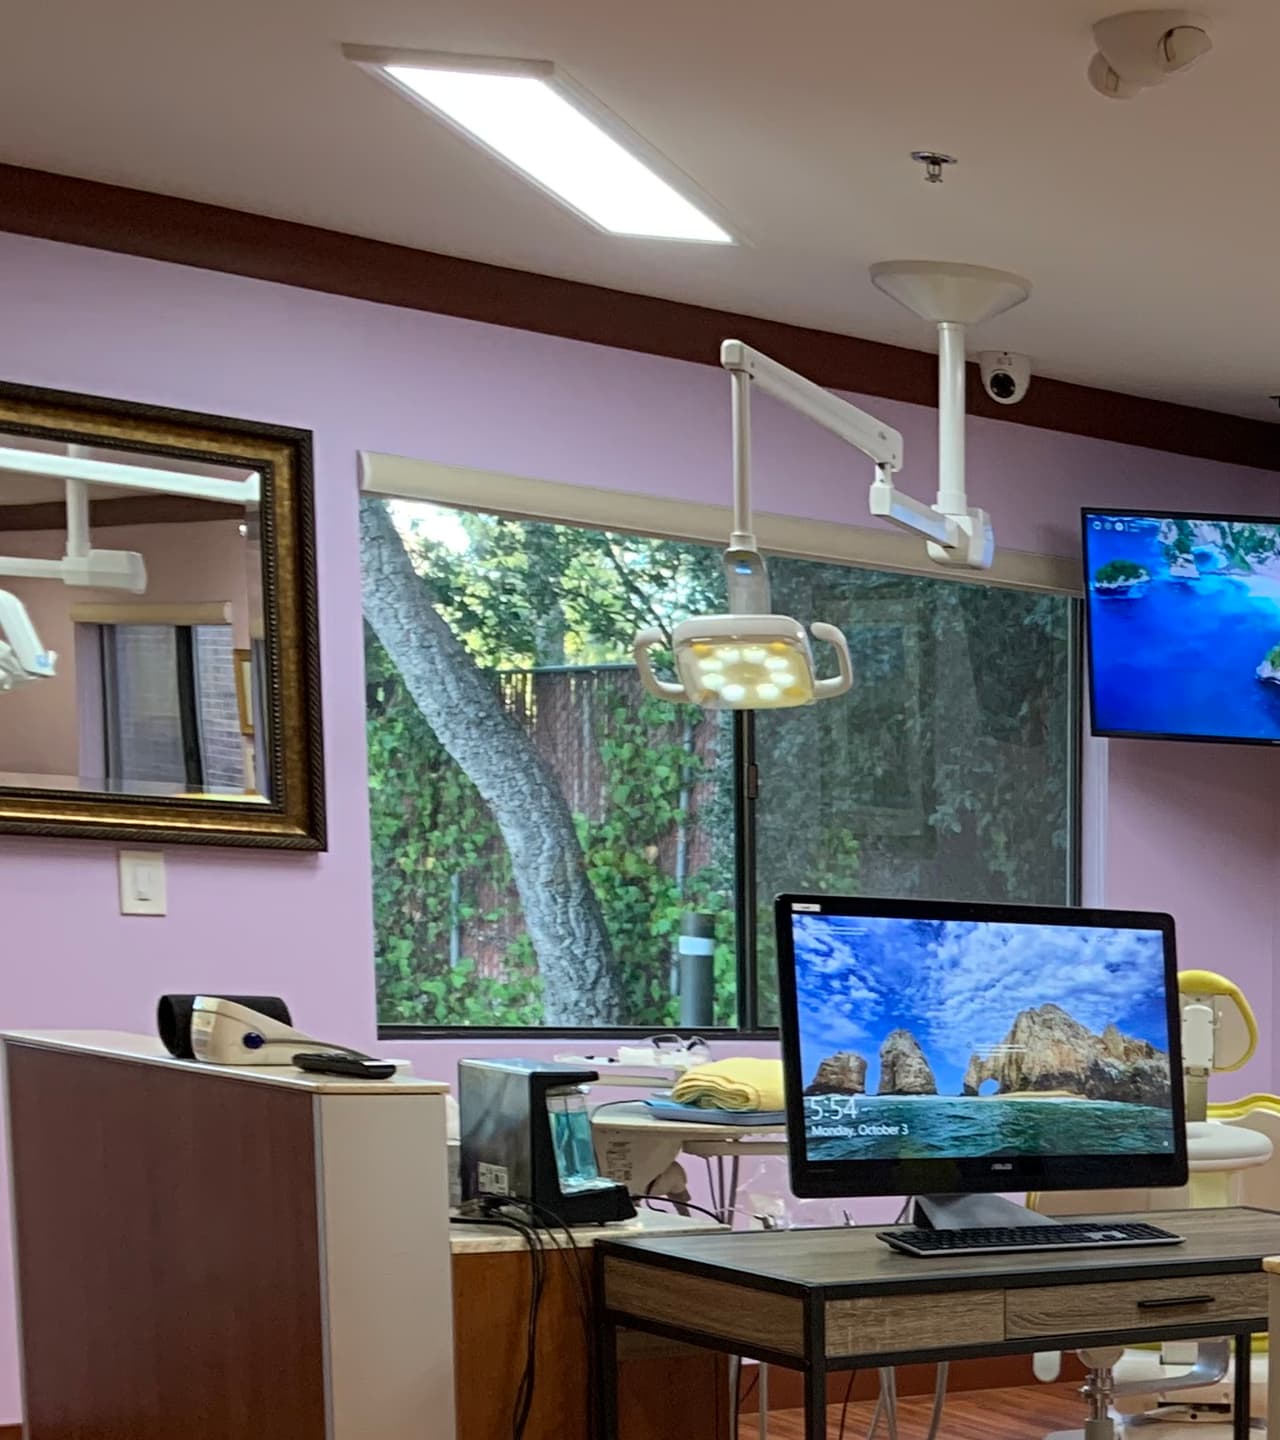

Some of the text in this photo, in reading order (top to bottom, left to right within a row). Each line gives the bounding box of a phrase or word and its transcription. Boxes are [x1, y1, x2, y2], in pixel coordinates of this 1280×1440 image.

[810, 1098, 858, 1120] 5:54
[858, 1124, 900, 1135] October
[901, 1123, 909, 1135] 3
